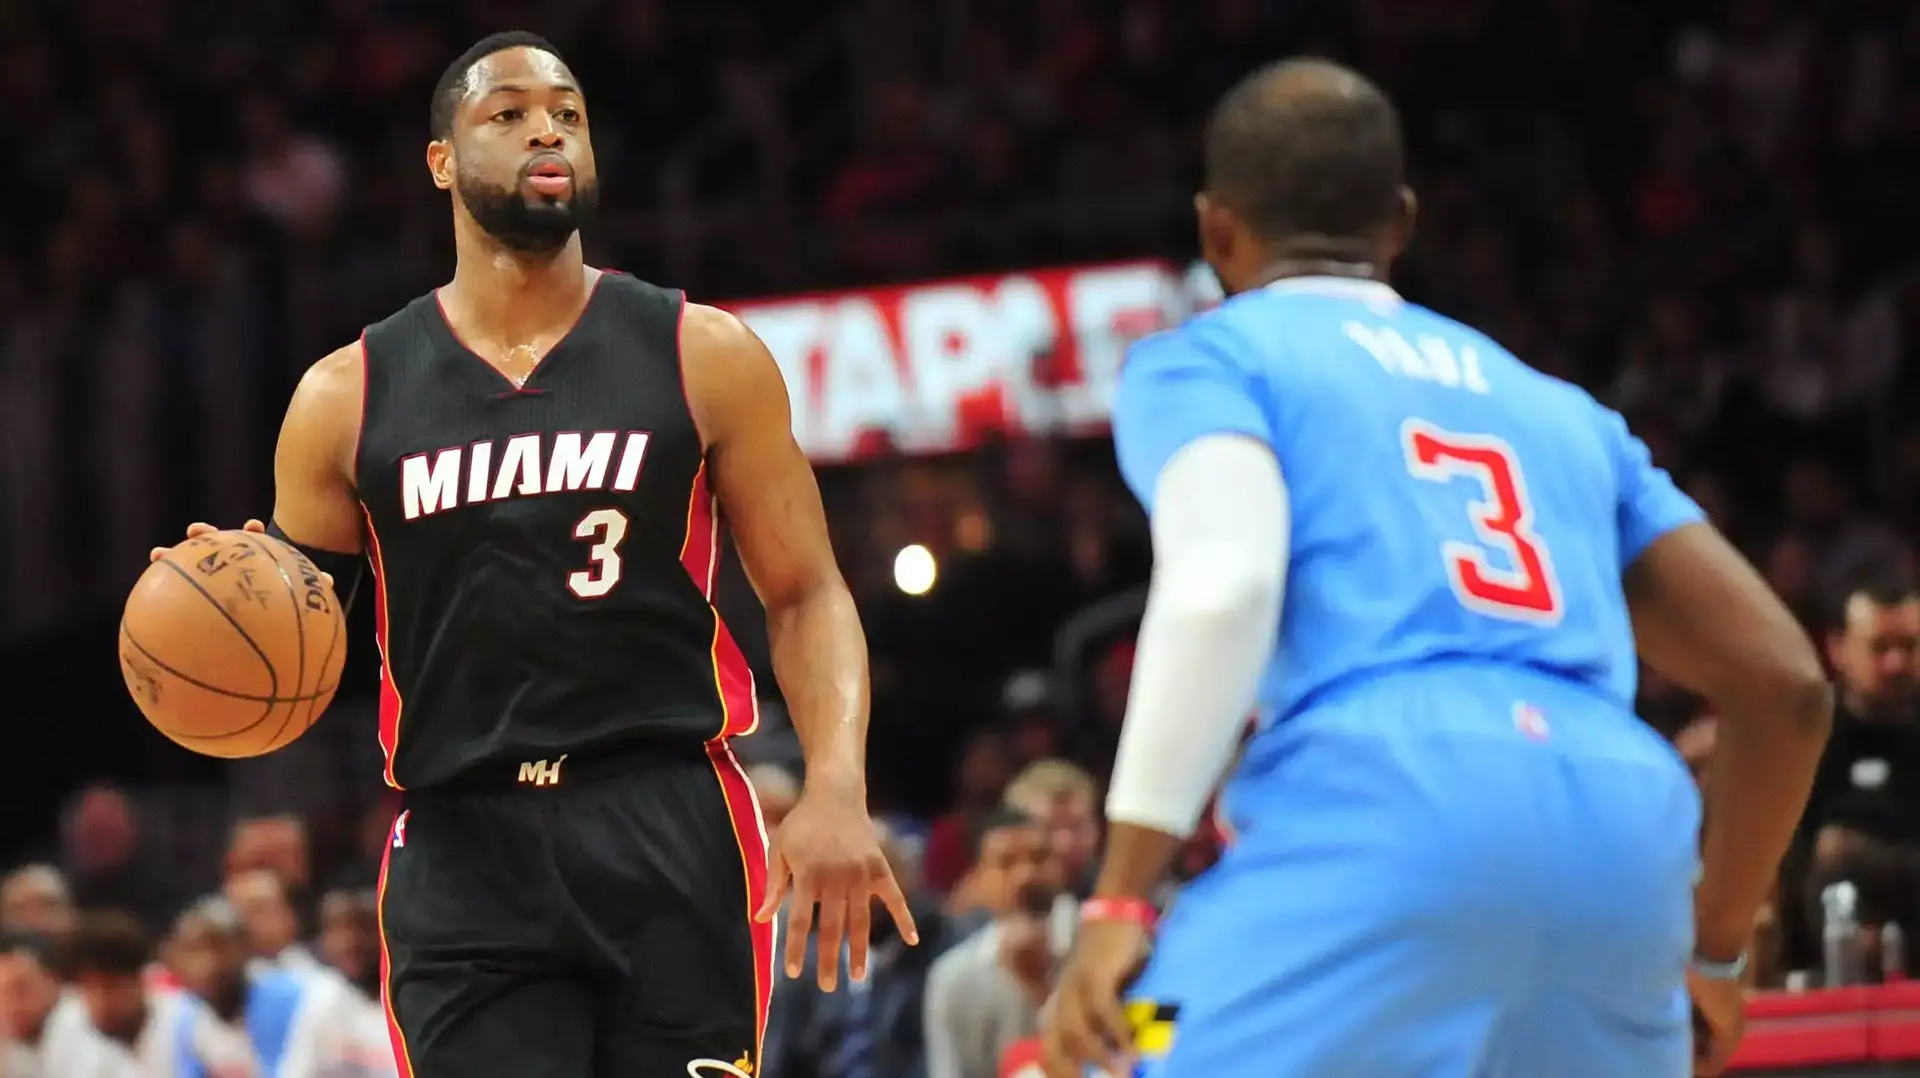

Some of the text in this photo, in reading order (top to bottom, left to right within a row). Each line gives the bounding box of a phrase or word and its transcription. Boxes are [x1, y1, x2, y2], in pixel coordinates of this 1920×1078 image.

[735, 262, 1224, 461] TAPLE
[401, 430, 651, 521] MIAMI
[1401, 417, 1564, 626] 3
[566, 507, 628, 600] 3
